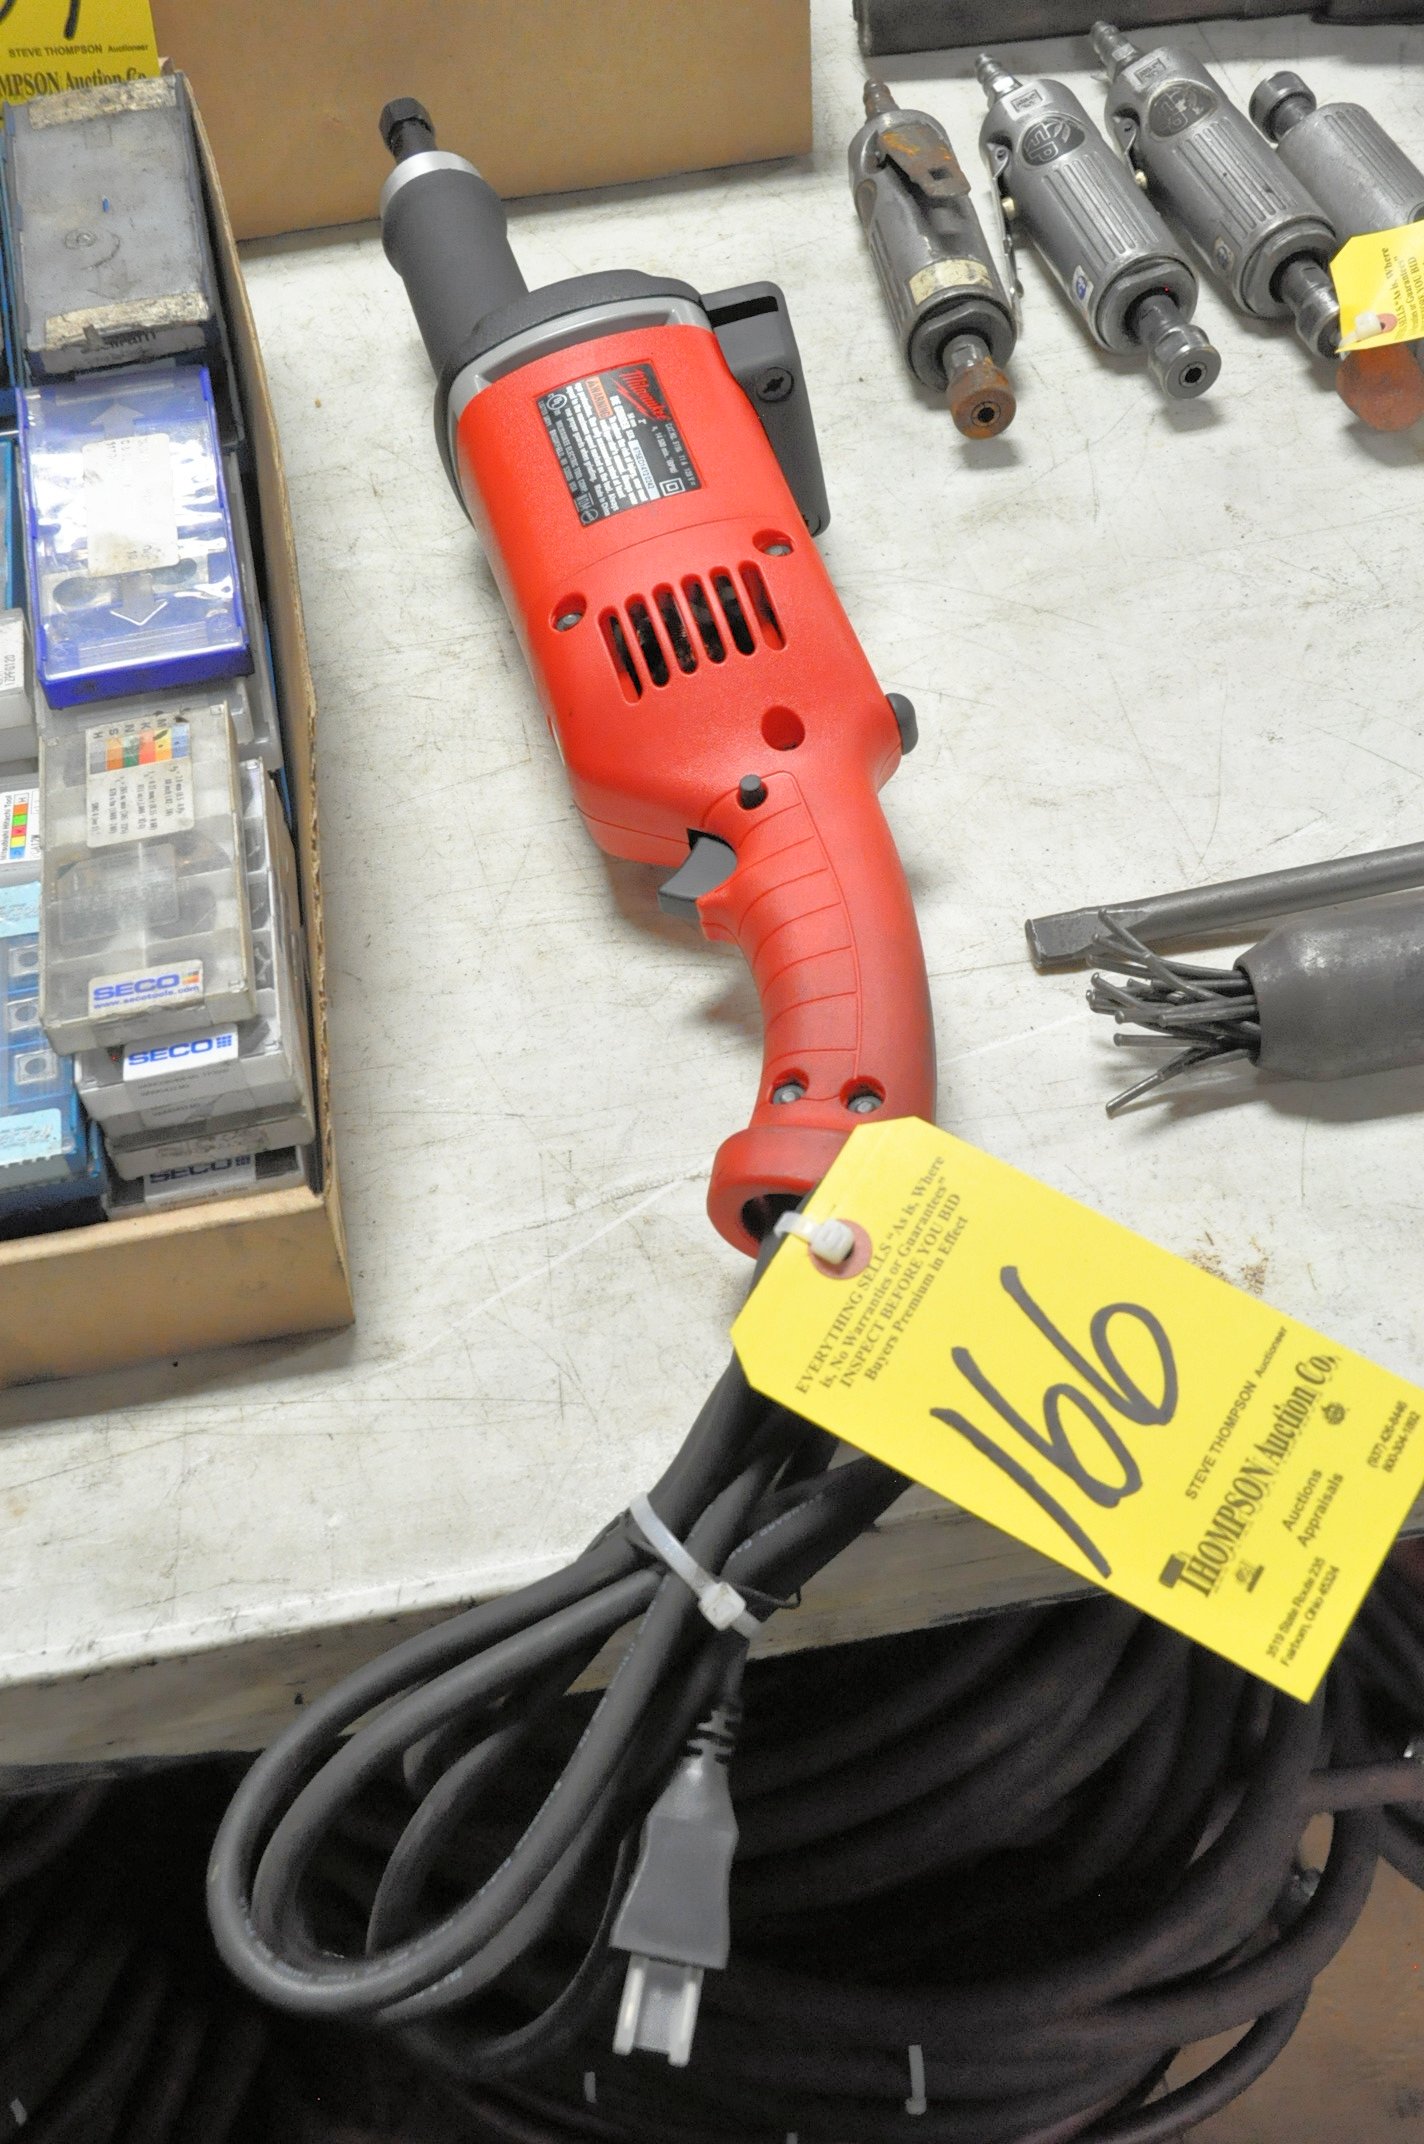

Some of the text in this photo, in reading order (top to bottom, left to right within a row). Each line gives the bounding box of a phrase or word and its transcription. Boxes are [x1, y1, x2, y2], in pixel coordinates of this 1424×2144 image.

[9, 44, 149, 58] STEVE THOMPSON Auctioneer
[588, 382, 612, 418] WARNING
[94, 974, 180, 1001] SECO
[128, 1038, 213, 1066] SECO
[910, 1156, 945, 1197] Where
[901, 1202, 920, 1216] is,
[839, 1194, 960, 1388] INSPECT BEFORE YOU BID
[857, 1243, 892, 1291] SELLS
[819, 1374, 838, 1388] is,
[829, 1351, 849, 1370] No
[841, 1277, 893, 1346] Warranties
[889, 1259, 902, 1276] or
[864, 1216, 968, 1381] Buyers Premium in Effect
[795, 1291, 863, 1393] EVERYTHING
[1185, 1326, 1287, 1500] STEVE THOMPSON Auctioneer
[1158, 1355, 1337, 1598] THOMPSON Auction Co.
[1282, 1469, 1323, 1532] Auctions
[1296, 1473, 1344, 1548] Appraisals
[1278, 1607, 1299, 1634] State
[1292, 1577, 1315, 1608] Route
[1304, 1596, 1324, 1621] Ohio
